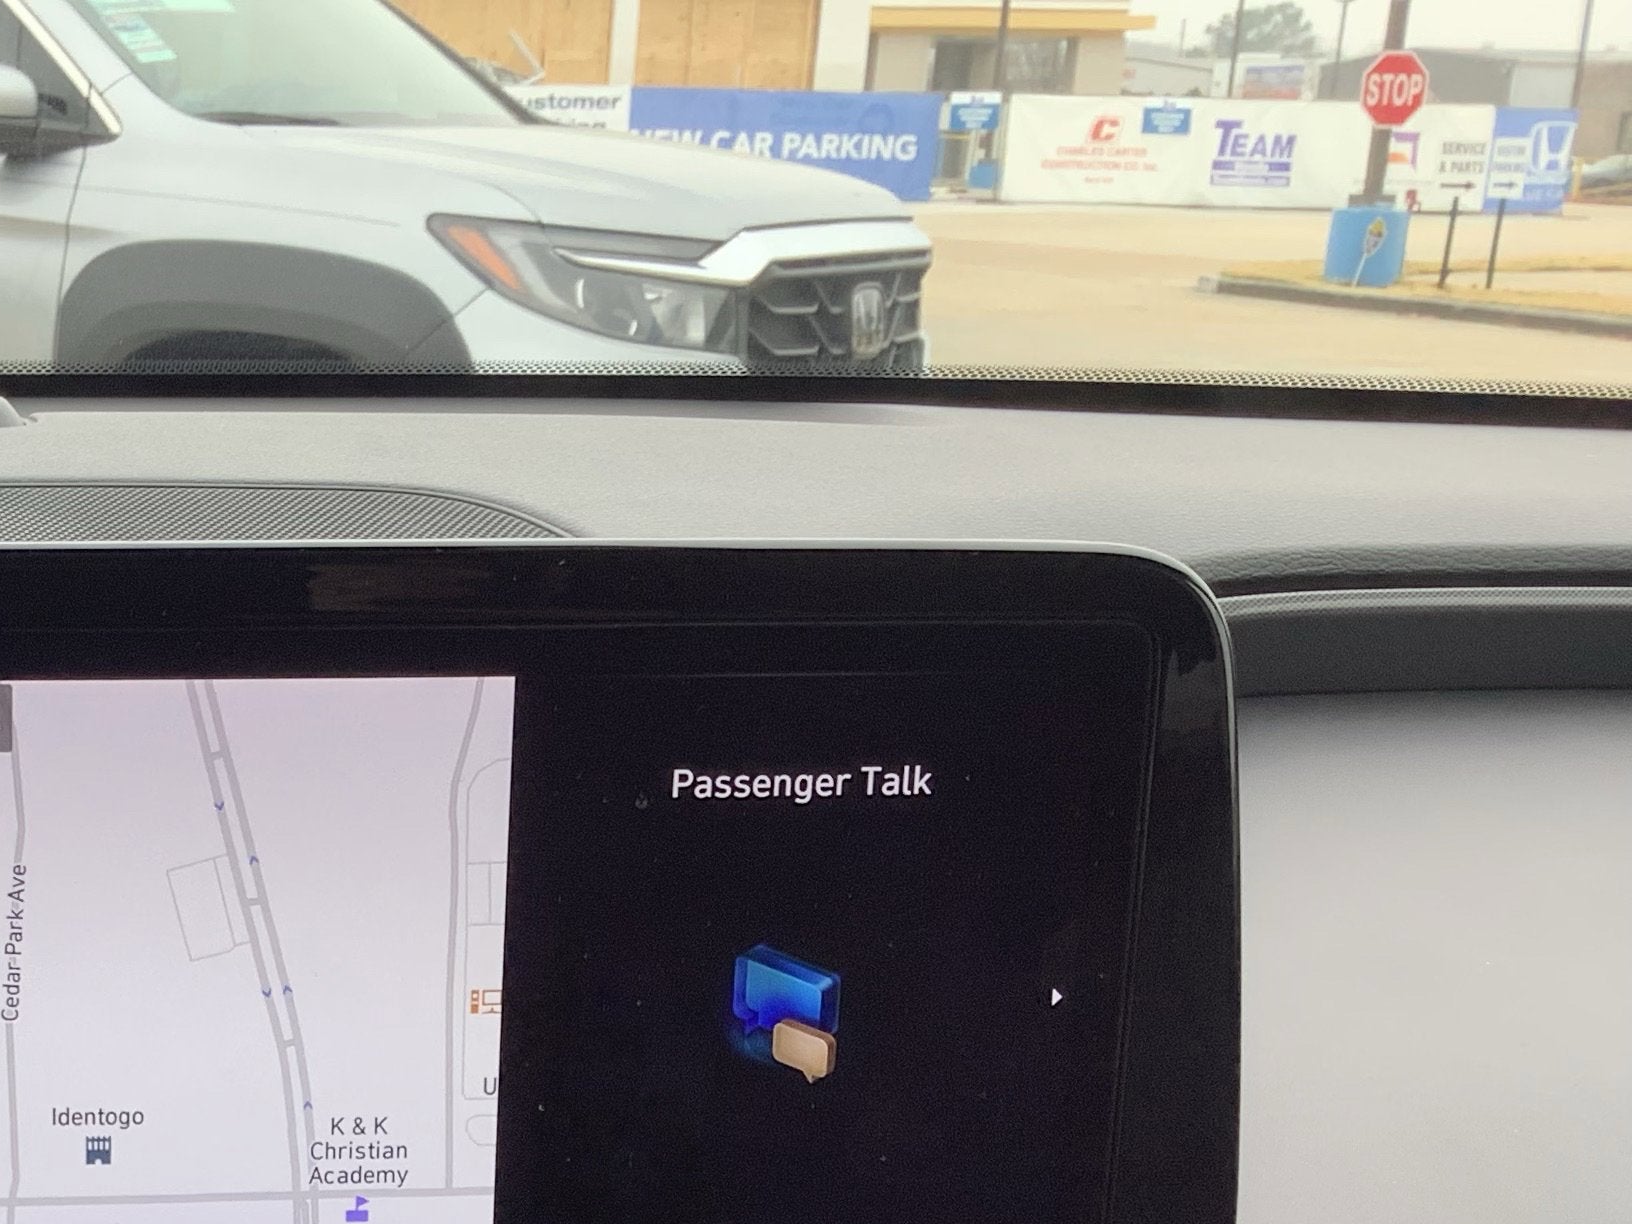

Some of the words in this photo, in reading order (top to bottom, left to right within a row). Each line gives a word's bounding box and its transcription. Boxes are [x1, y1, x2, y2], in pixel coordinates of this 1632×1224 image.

[525, 92, 622, 111] ustomer
[1366, 72, 1424, 108] STOP
[710, 130, 775, 159] CAR
[781, 131, 919, 162] PARKING
[1442, 141, 1487, 155] SERVICE
[671, 768, 852, 804] Passenger
[861, 765, 933, 797] Talk
[7, 864, 27, 903] Ave
[4, 909, 24, 956] Park
[0, 961, 22, 1023] Cedar
[51, 1107, 145, 1130] Identogo
[330, 1117, 346, 1136] K
[352, 1117, 367, 1136] &
[374, 1117, 389, 1136] K
[309, 1141, 409, 1161] Christian
[308, 1166, 409, 1187] Academy
